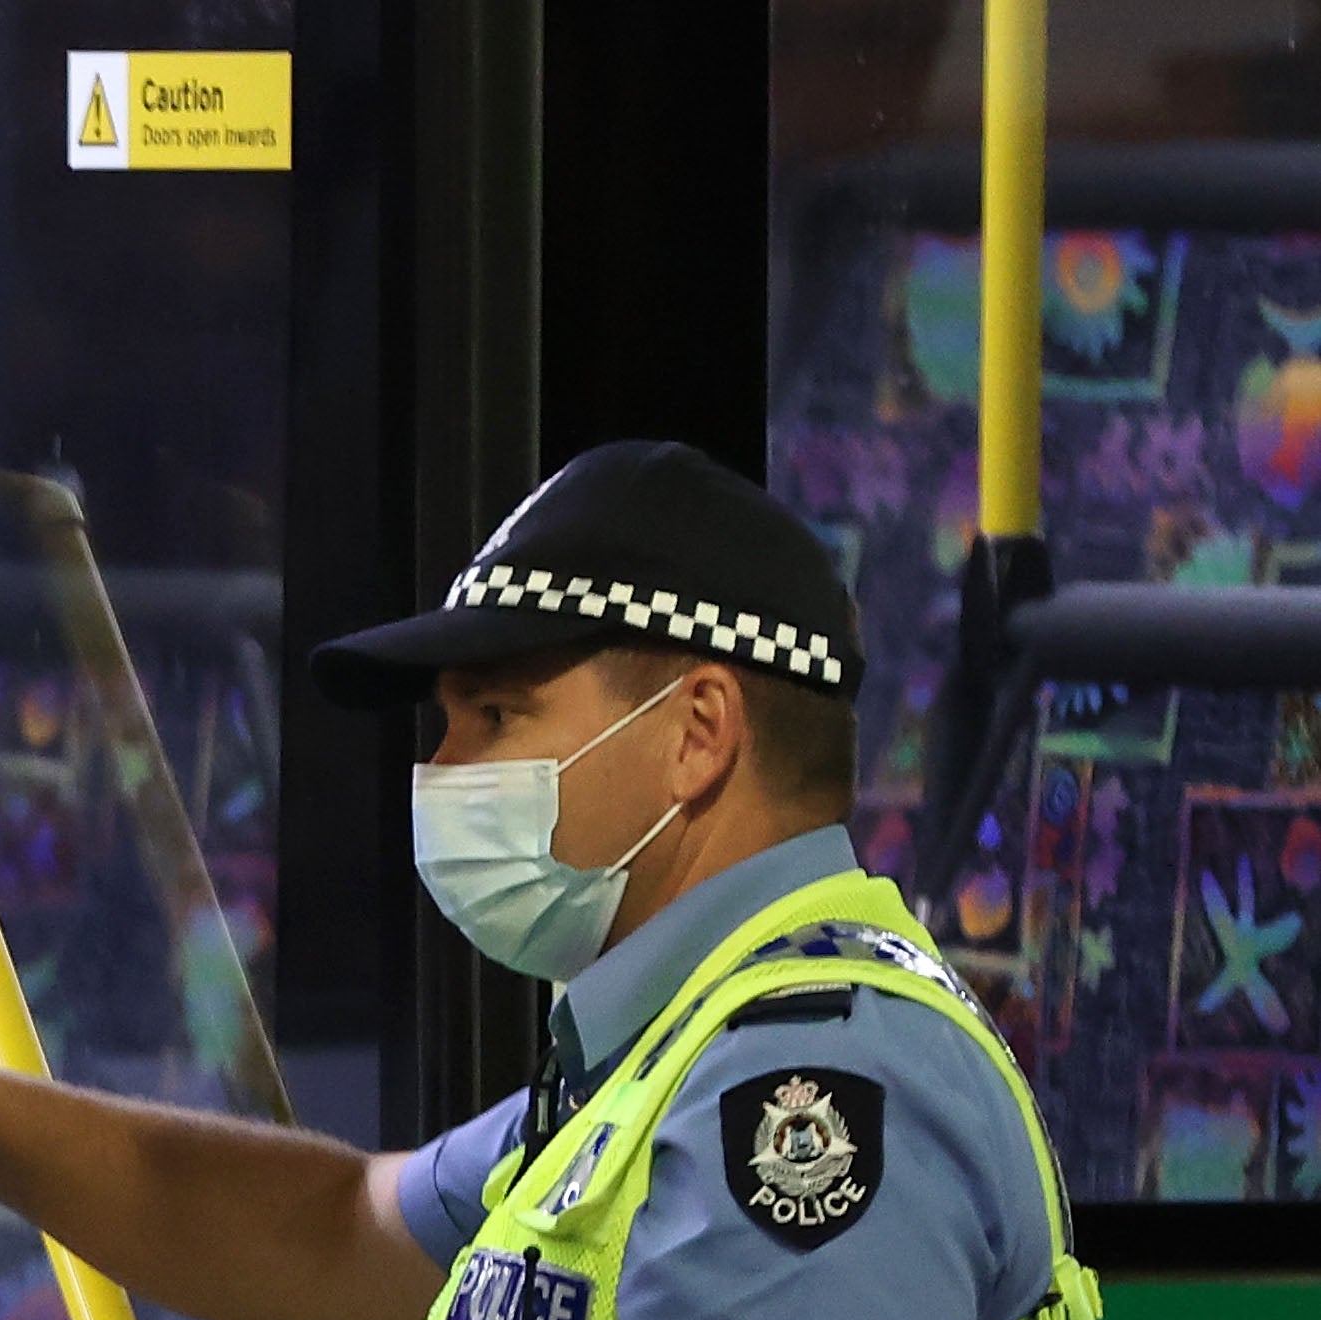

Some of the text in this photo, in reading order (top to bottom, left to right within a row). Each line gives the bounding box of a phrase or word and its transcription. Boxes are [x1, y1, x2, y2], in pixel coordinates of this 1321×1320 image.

[142, 77, 225, 112] Caution
[143, 124, 182, 146] Doors
[187, 126, 220, 149] open
[748, 1176, 867, 1226] POLICE
